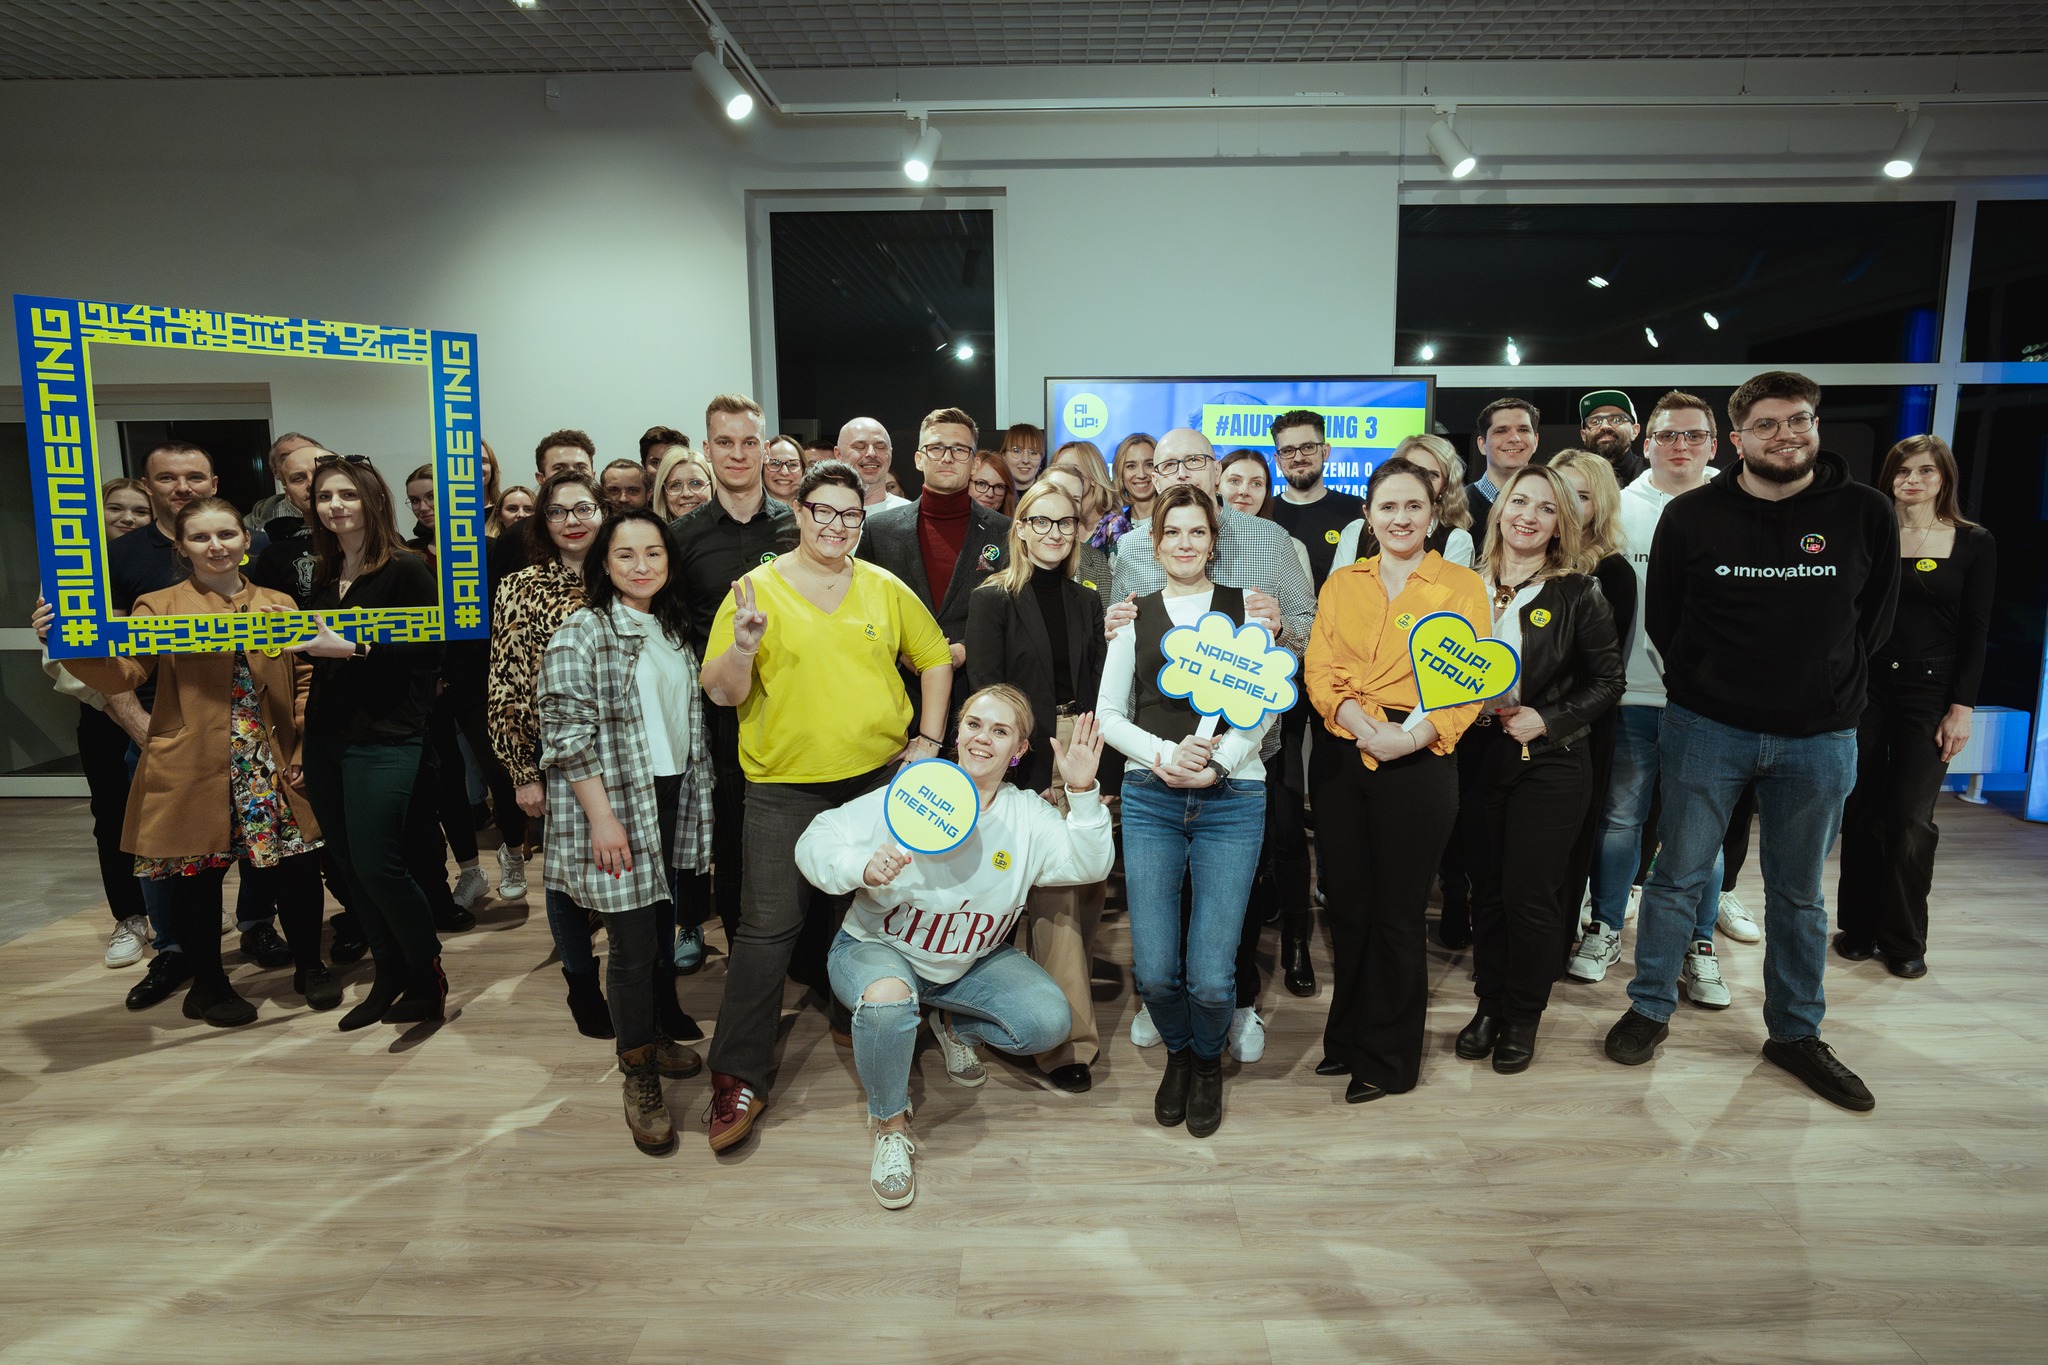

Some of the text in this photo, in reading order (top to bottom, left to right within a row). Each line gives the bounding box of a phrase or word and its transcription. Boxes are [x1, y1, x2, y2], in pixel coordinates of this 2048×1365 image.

[1074, 404, 1087, 414] AI
[1074, 417, 1098, 428] UP!
[1365, 415, 1378, 440] 3
[30, 307, 99, 647] #AIUPMEETING
[441, 339, 482, 629] #AIUPMEETING
[1364, 461, 1373, 478] O
[1733, 563, 1837, 578] innovation
[1195, 641, 1263, 676] NAPISZ
[1419, 648, 1485, 695] TORUŃ
[1437, 636, 1492, 674] AIUP!
[1178, 656, 1278, 704] TO LEPIEJ
[895, 788, 959, 839] MEETING
[917, 785, 955, 816] AIUP!
